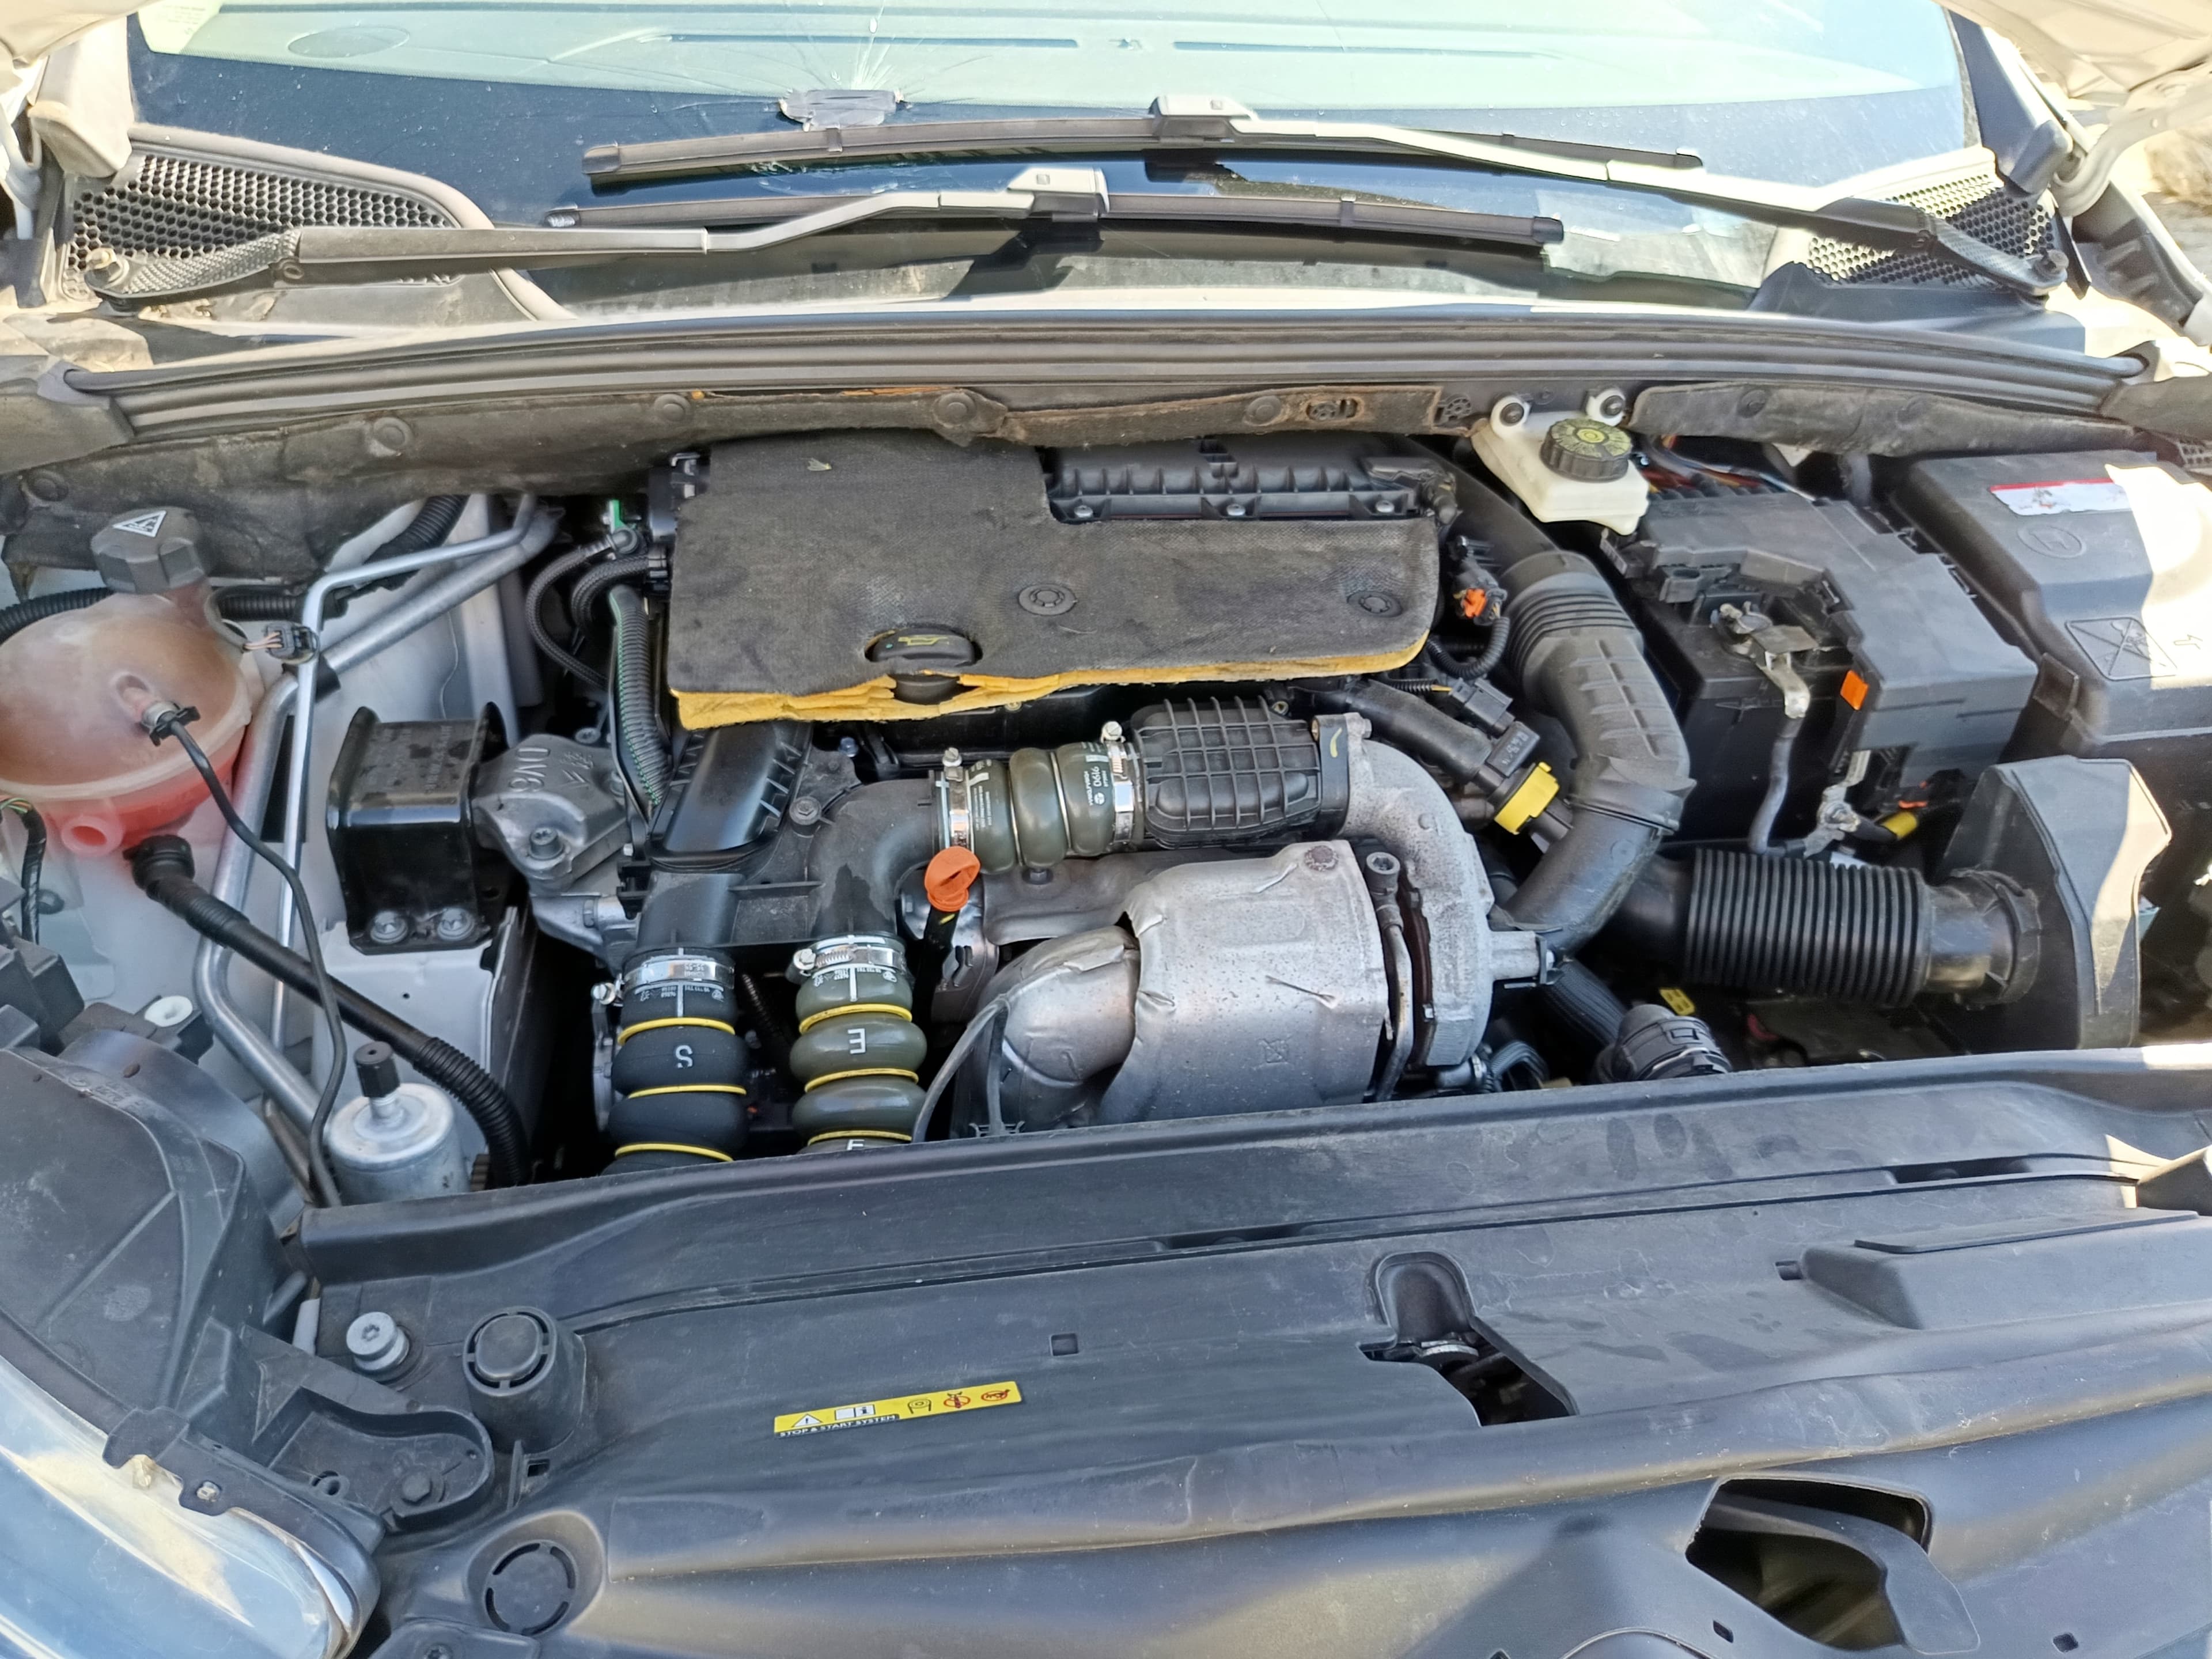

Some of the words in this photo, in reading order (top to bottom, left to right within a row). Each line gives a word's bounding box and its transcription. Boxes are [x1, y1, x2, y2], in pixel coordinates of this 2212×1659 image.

[847, 1028, 866, 1055] E
[675, 1044, 693, 1069] S
[779, 1427, 808, 1437] STOP
[820, 1421, 852, 1430] START
[855, 1414, 896, 1426] SYSTEM
